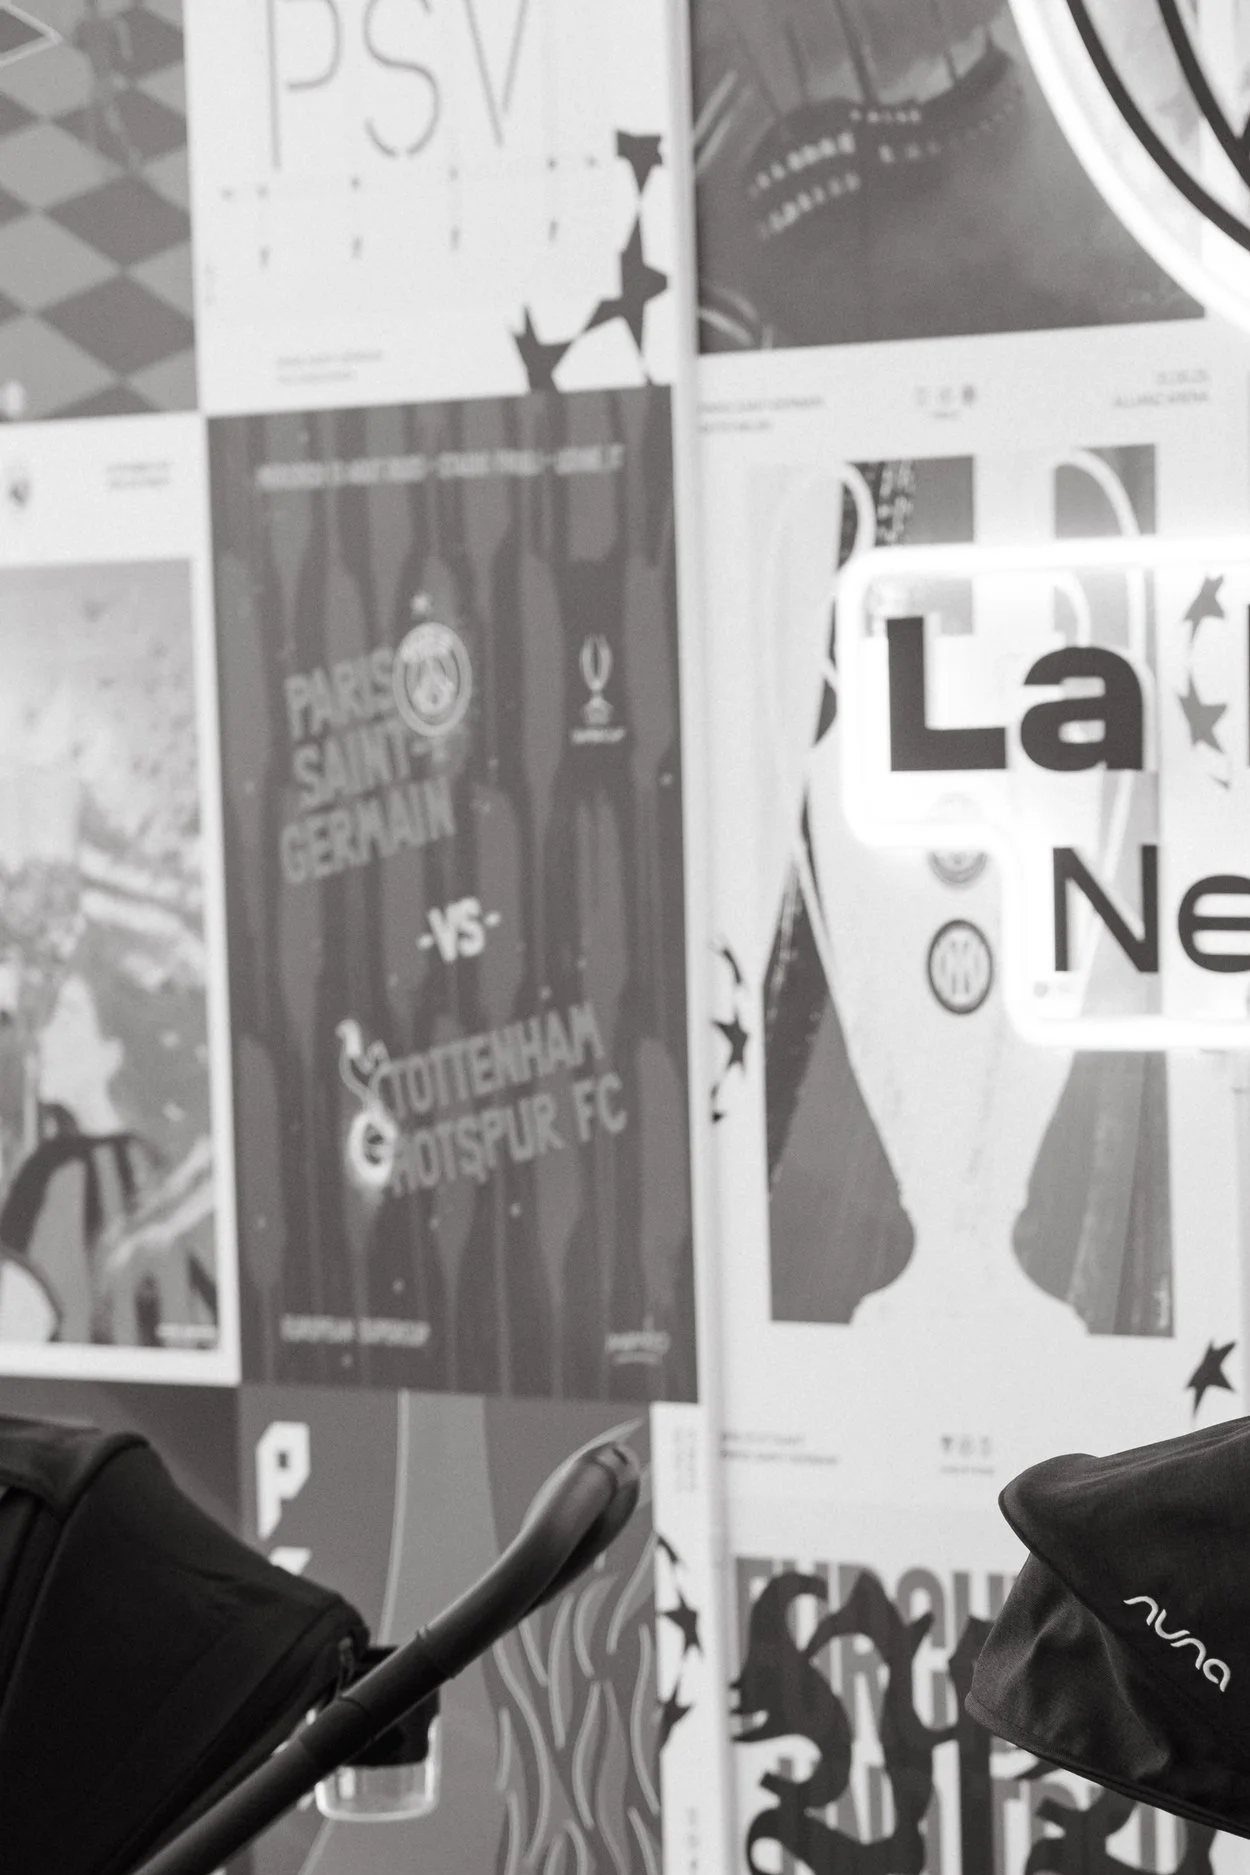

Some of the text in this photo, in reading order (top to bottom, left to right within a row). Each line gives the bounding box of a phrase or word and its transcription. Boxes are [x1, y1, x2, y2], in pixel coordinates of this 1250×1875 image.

[284, 646, 399, 741] PARIS
[886, 616, 1145, 772] La
[279, 776, 457, 885] GERMAIN
[378, 1000, 607, 1120] TOTTENHAM
[572, 1071, 629, 1144] FC
[1123, 1595, 1231, 1693] nuna
